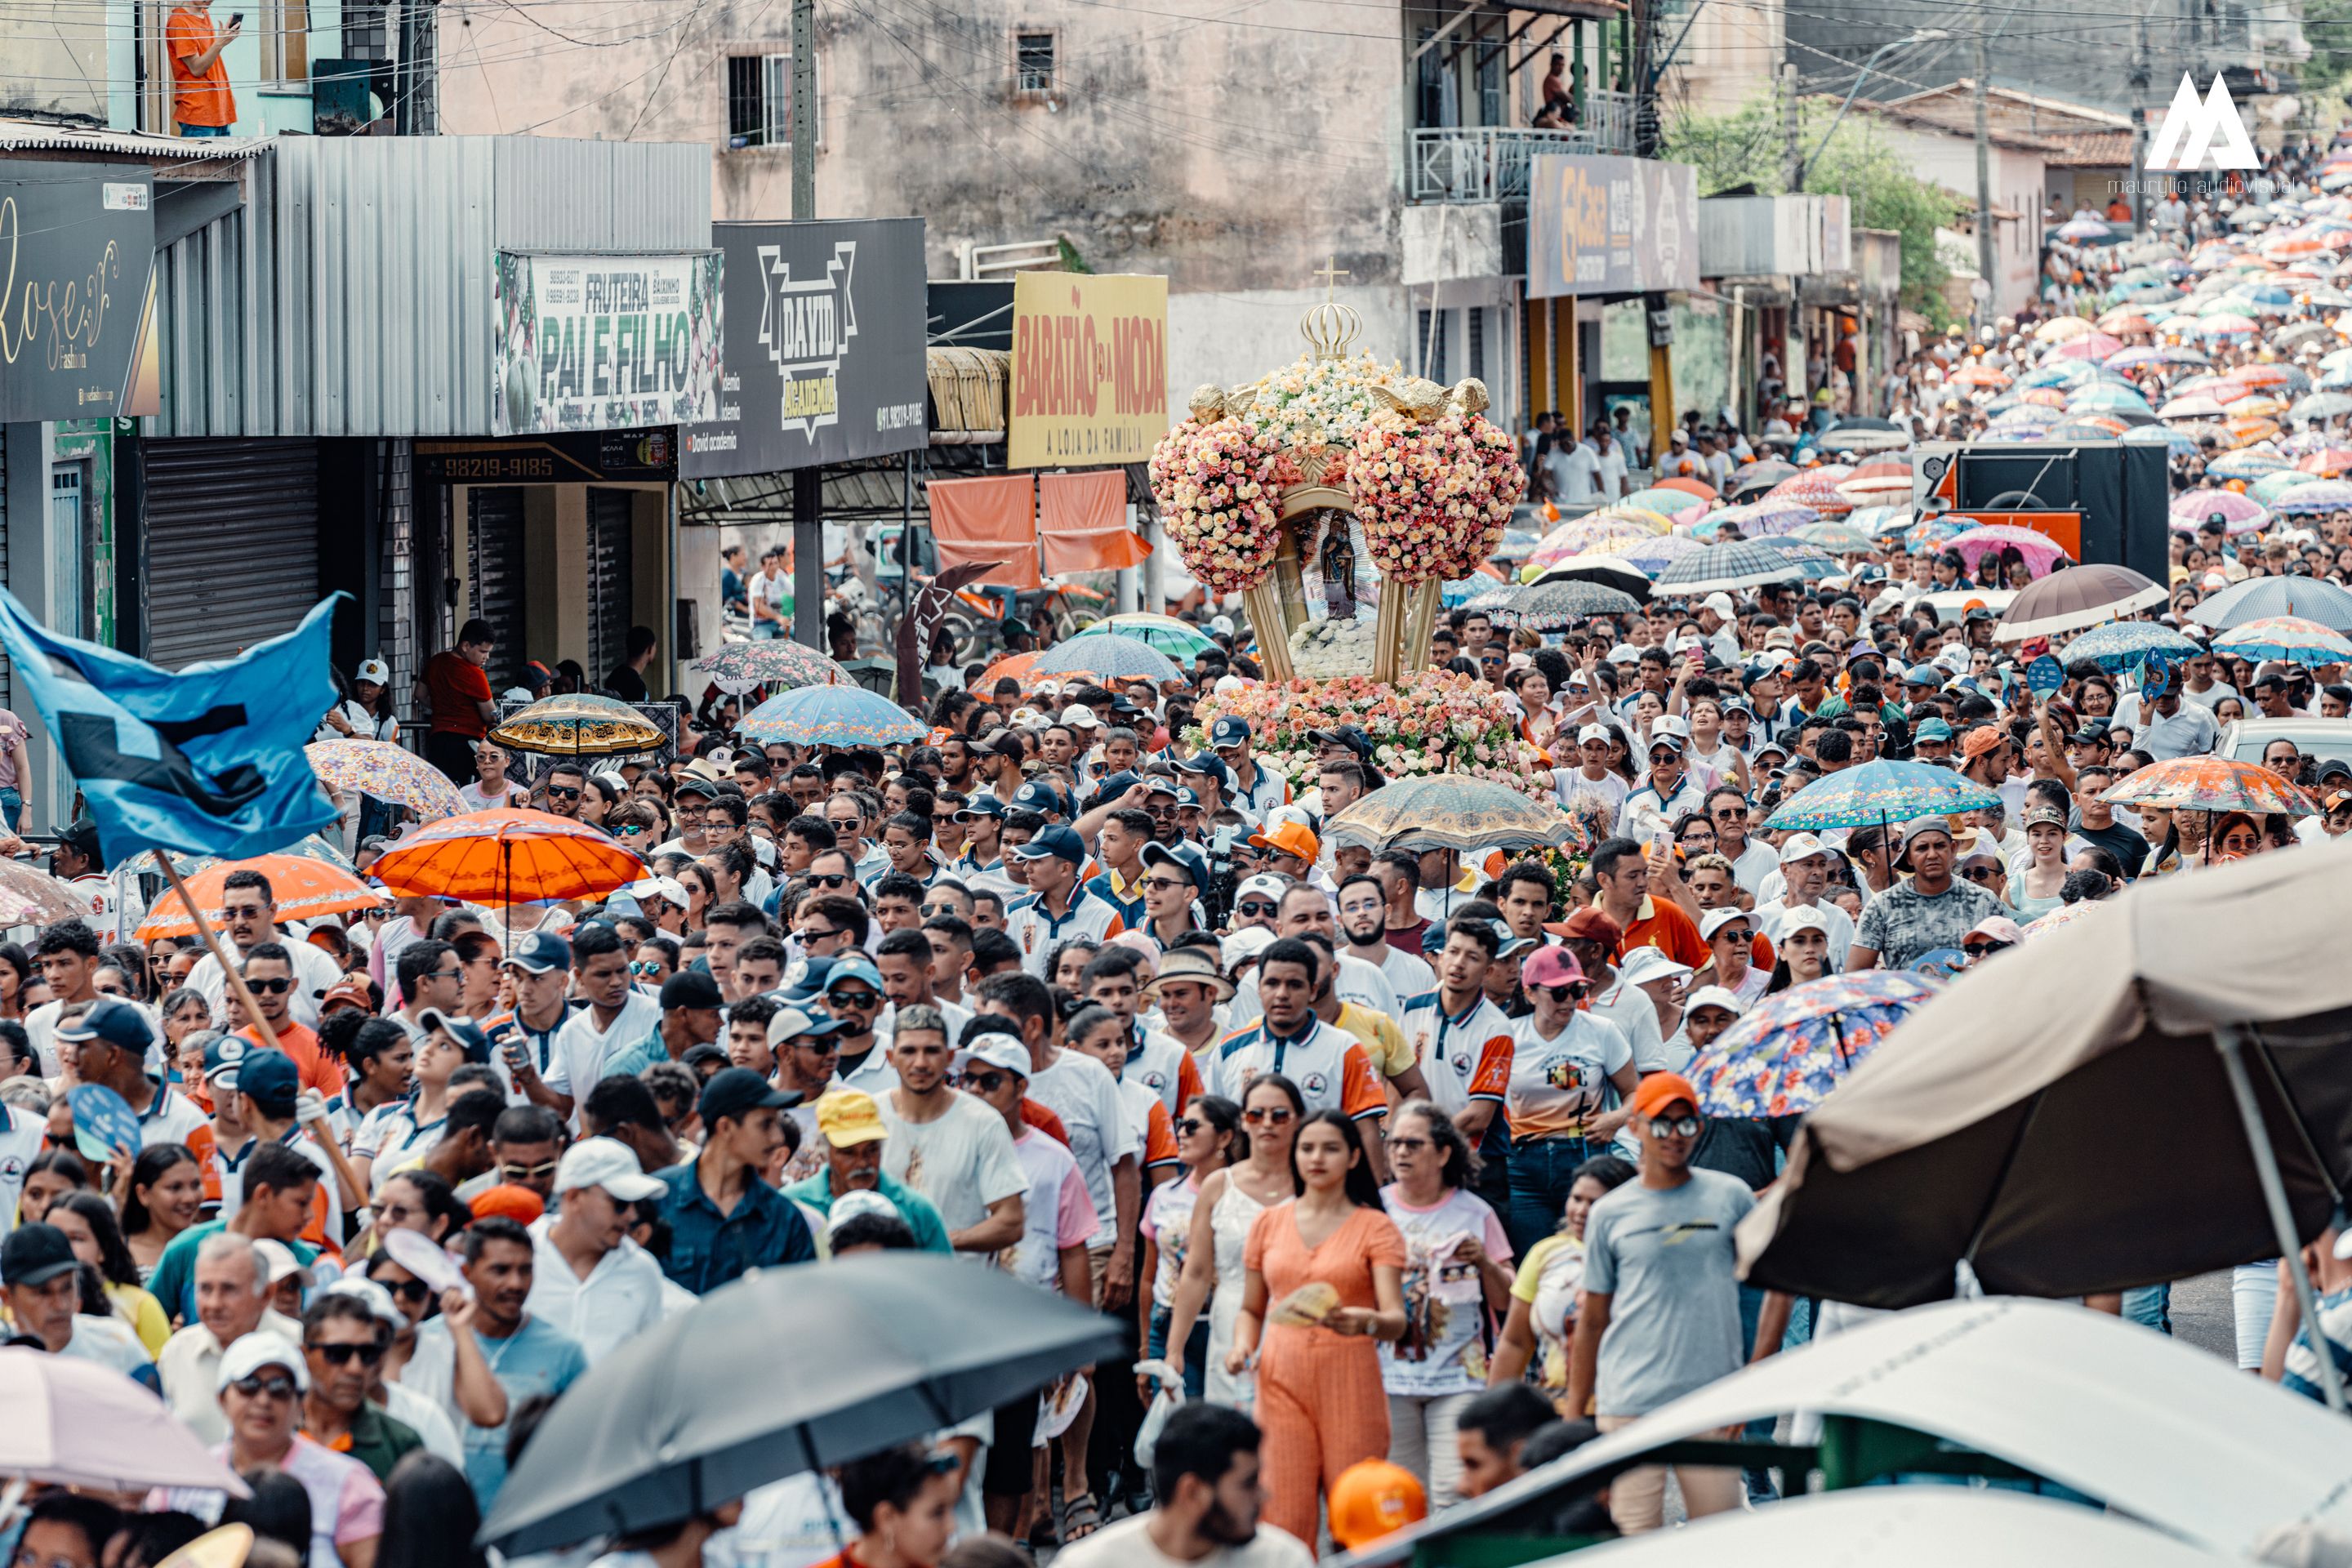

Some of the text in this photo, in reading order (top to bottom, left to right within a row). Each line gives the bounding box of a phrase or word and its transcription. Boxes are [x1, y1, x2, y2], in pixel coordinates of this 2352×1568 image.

[586, 272, 648, 314] FRUTEIRA
[653, 278, 679, 294] BAIXINHO
[783, 294, 835, 359] DAVID
[60, 343, 87, 369] Fashion
[540, 310, 690, 399] PAI E FILHO
[1016, 285, 1166, 418] BARATÃO DA MODA
[784, 376, 836, 421] ACADEMIA
[693, 430, 737, 452] David academia
[1047, 418, 1143, 456] A LOJA DA FAMÍLIA
[445, 457, 553, 477] 98219-9185
